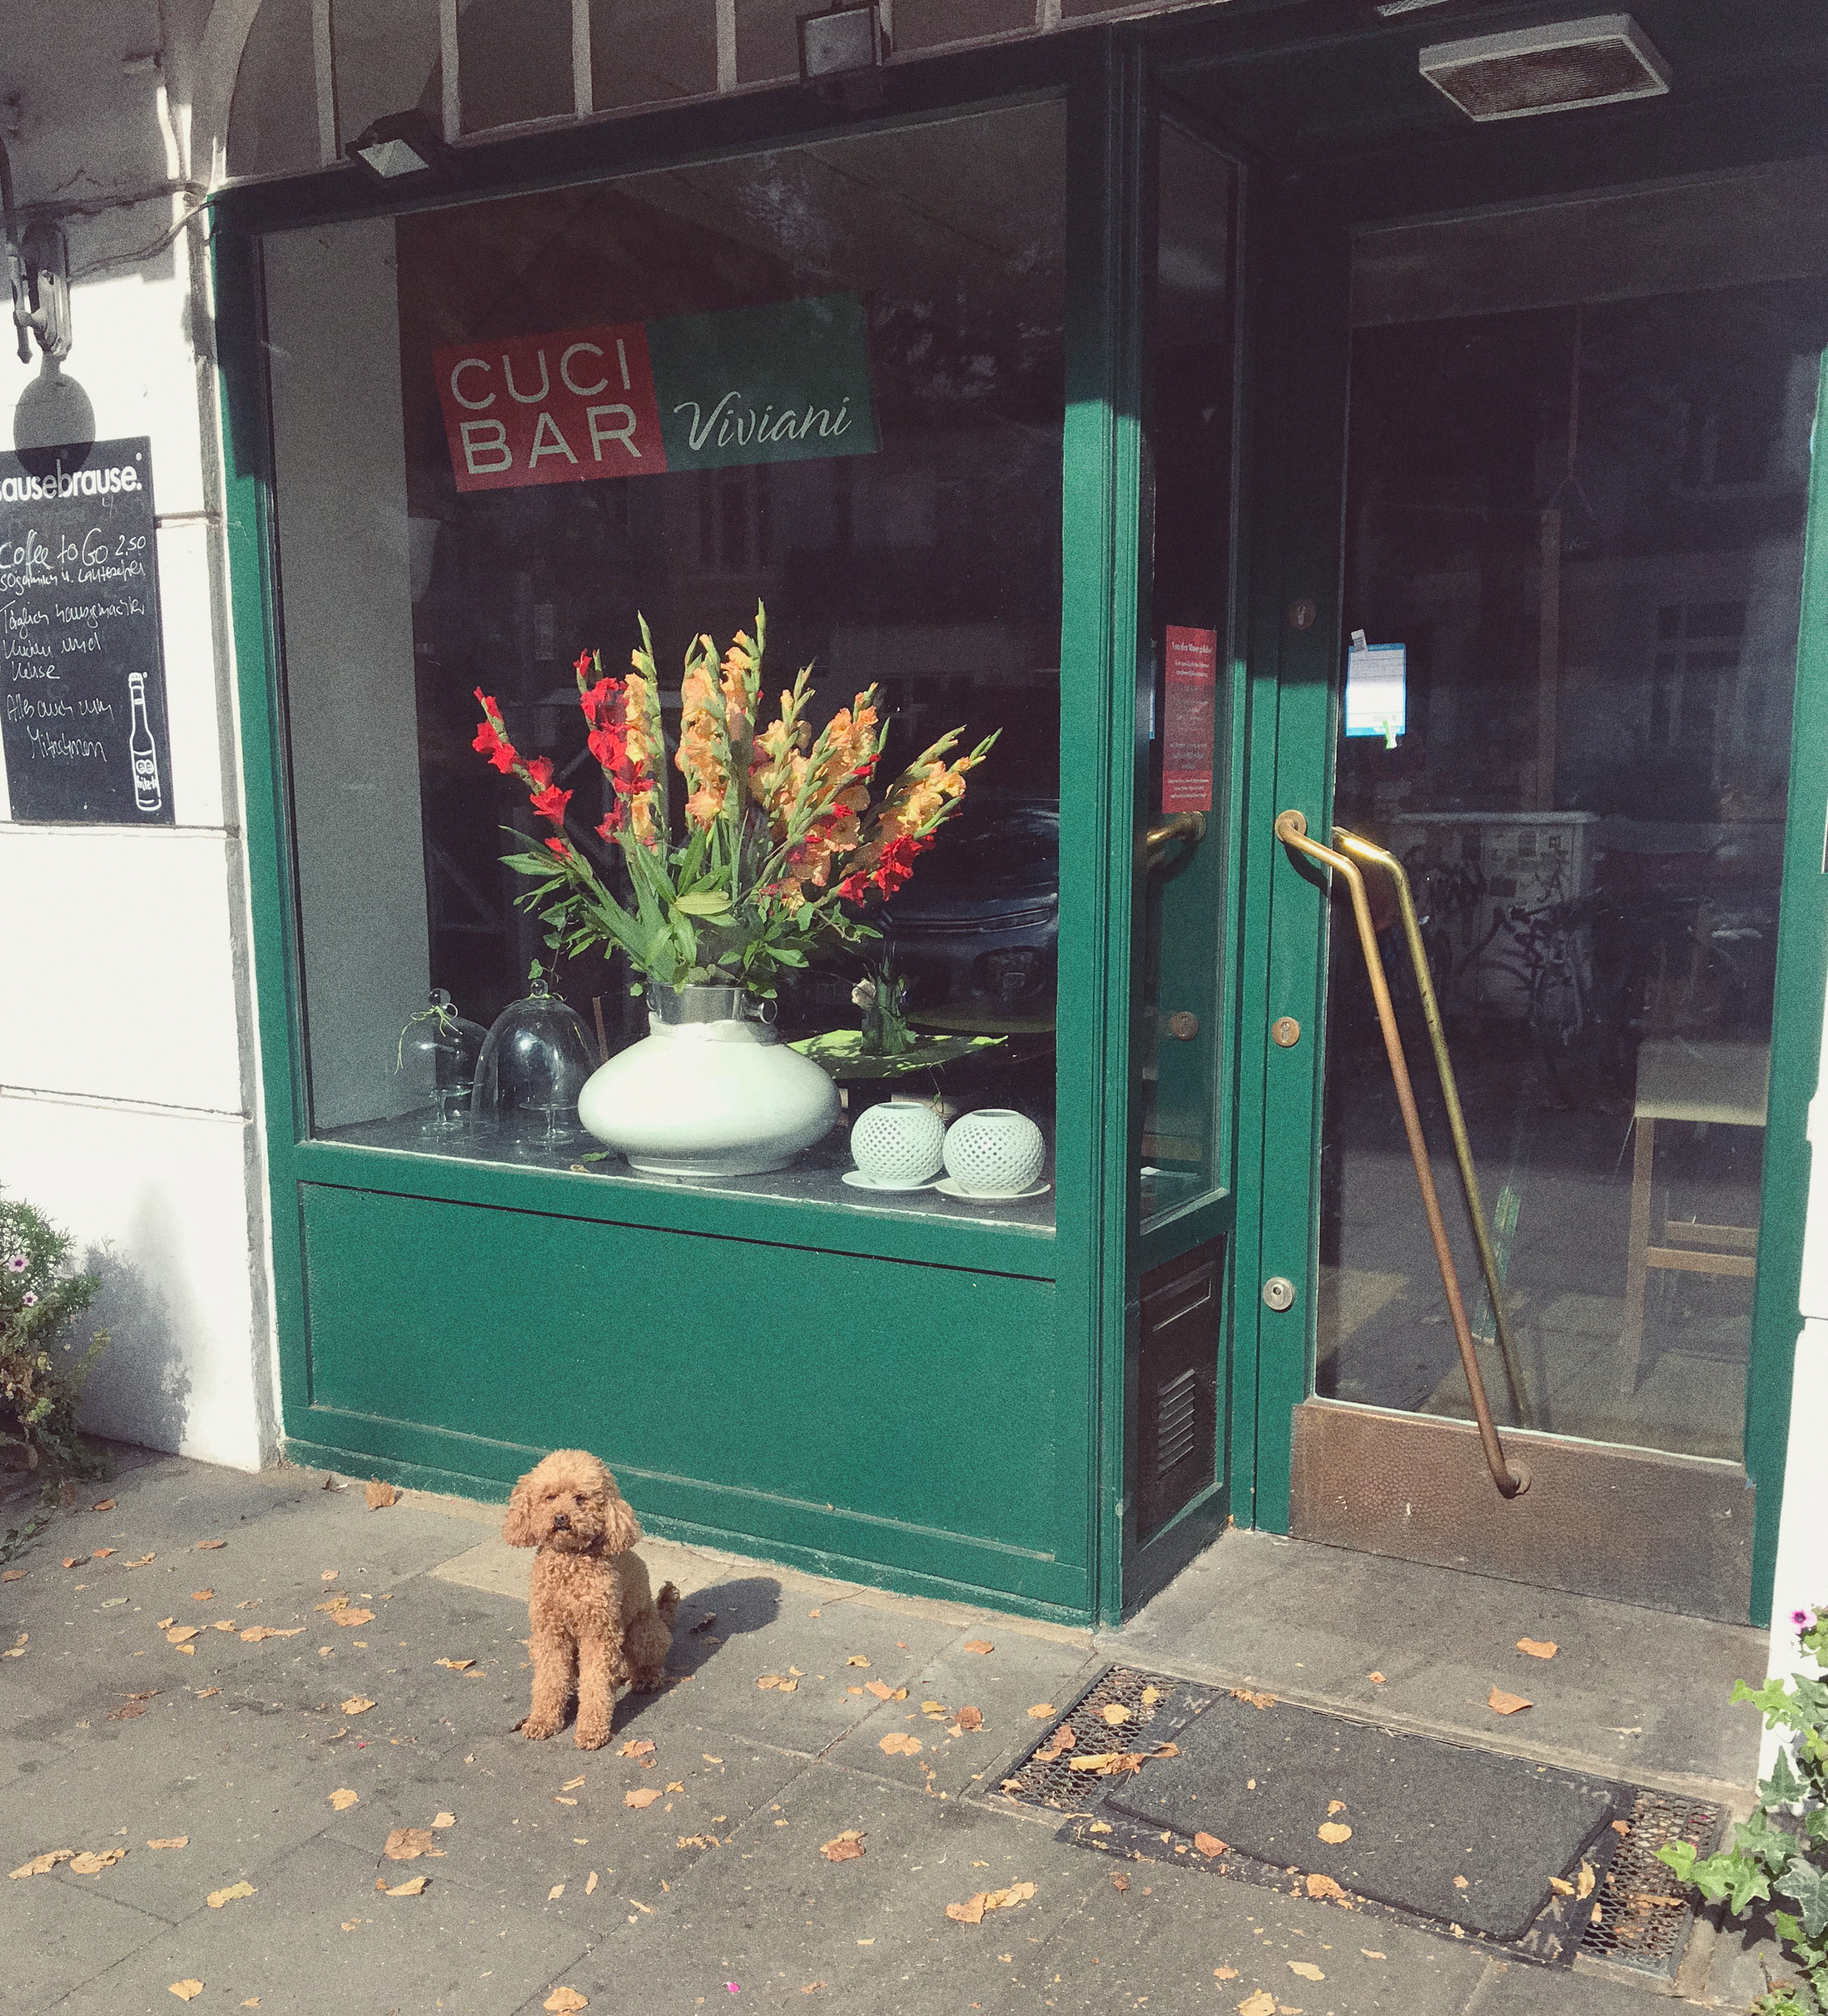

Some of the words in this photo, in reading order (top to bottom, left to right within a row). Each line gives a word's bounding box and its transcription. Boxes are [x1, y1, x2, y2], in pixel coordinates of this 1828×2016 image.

[451, 339, 631, 409] CUCI
[459, 403, 642, 474] BAR
[673, 391, 851, 450] Viviani
[0, 458, 142, 502] ausebrause.
[57, 534, 78, 564] to
[82, 527, 108, 567] Go
[37, 700, 74, 717] auch
